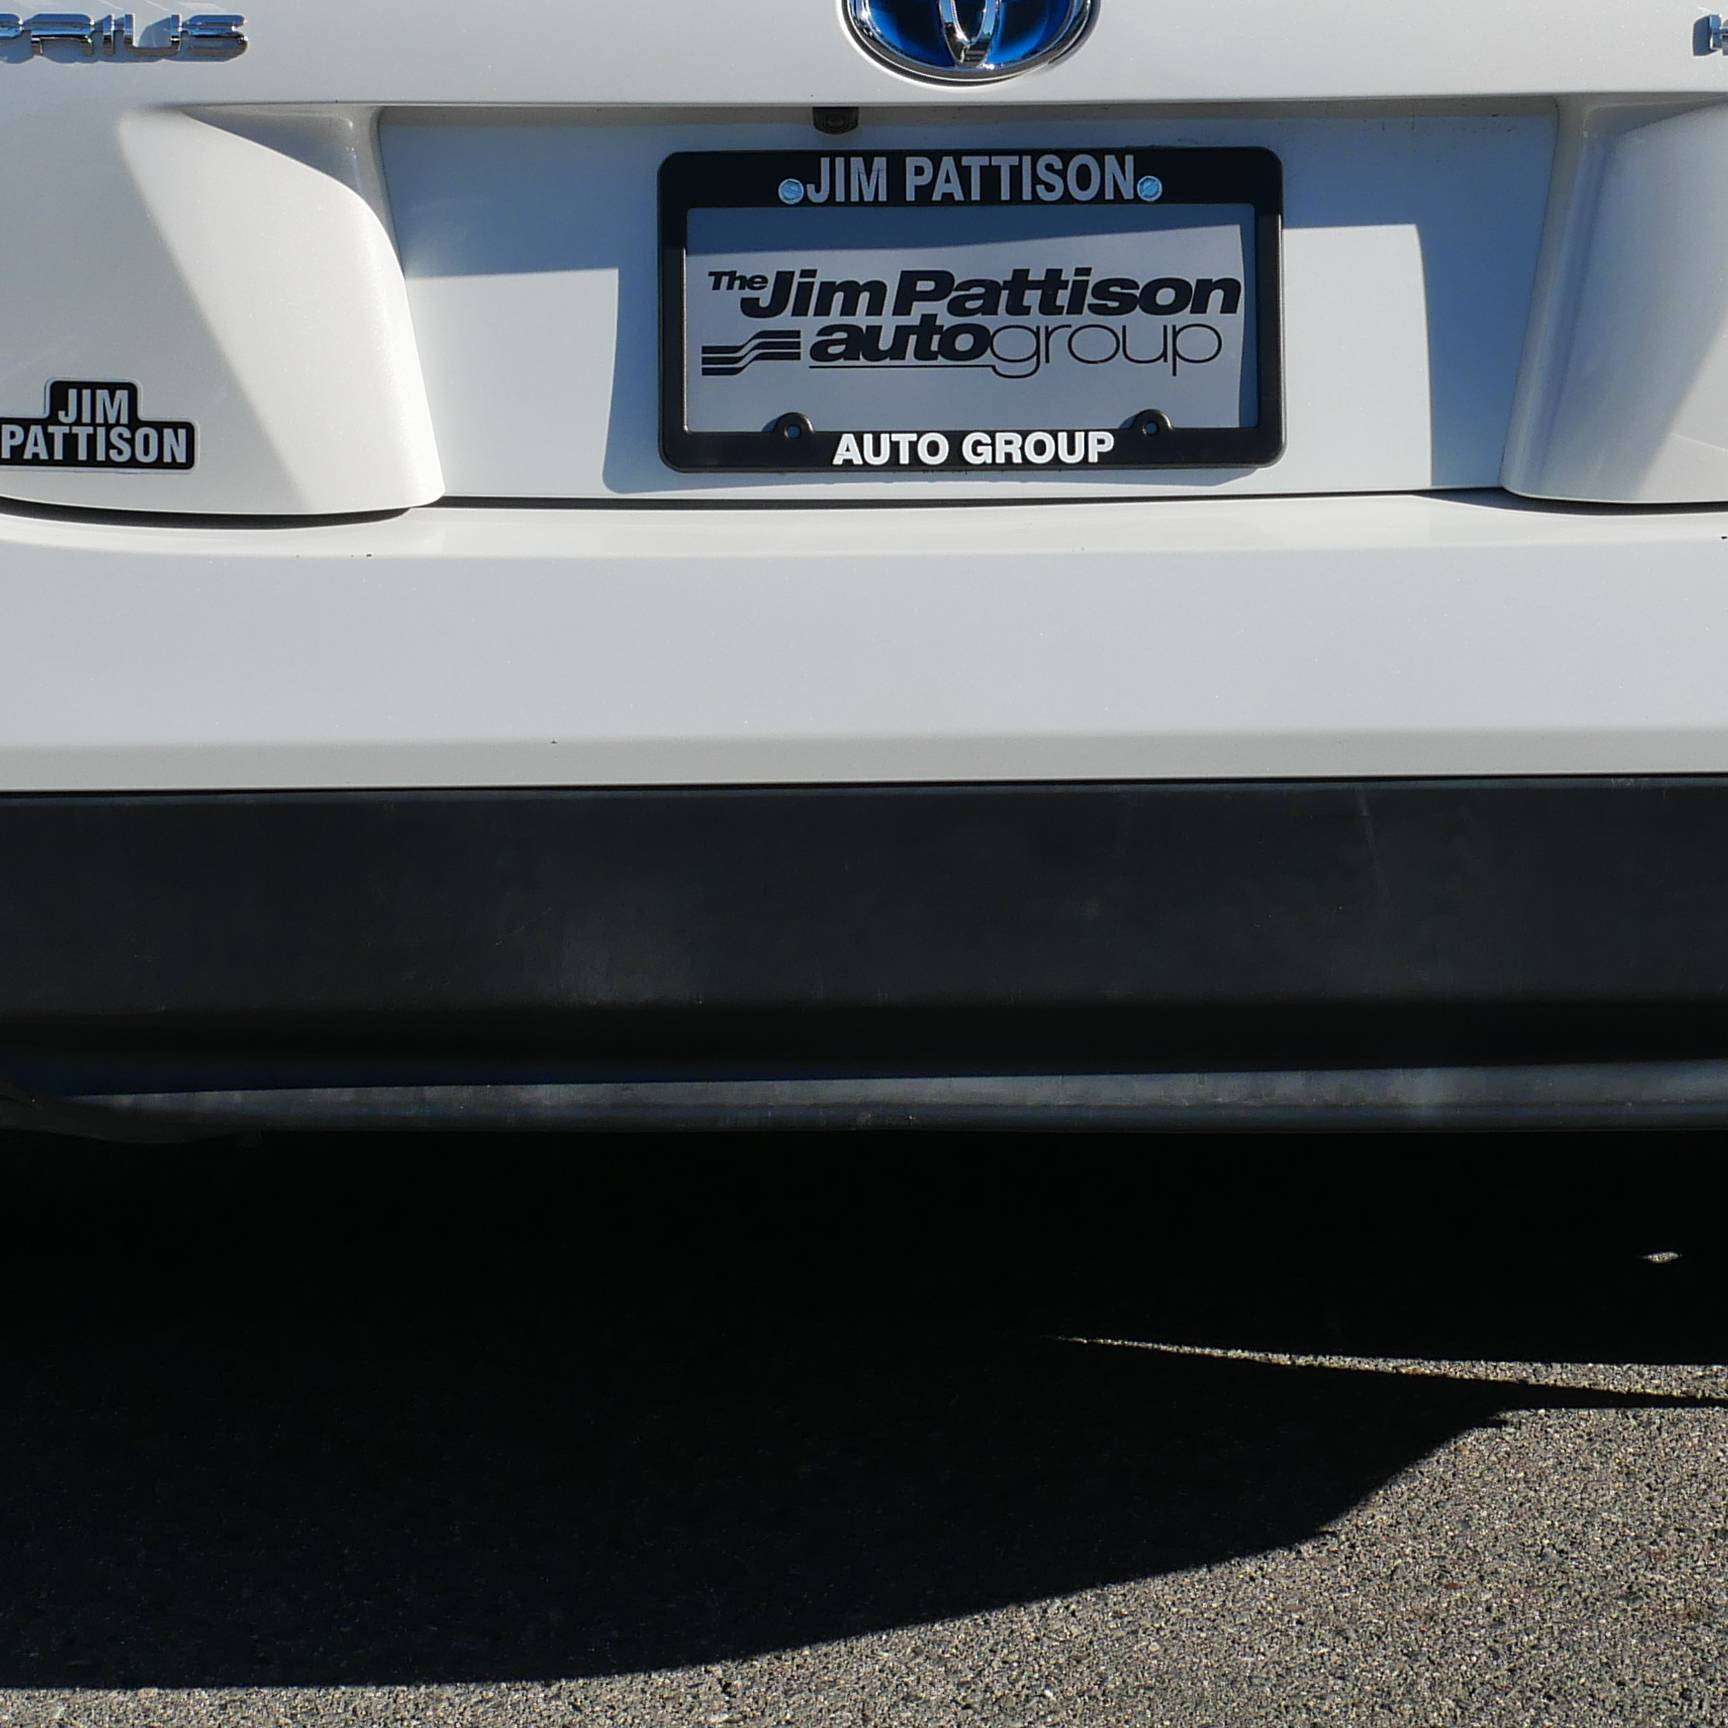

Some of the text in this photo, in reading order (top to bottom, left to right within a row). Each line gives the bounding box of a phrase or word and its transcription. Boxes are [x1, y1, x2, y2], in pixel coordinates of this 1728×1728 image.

[806, 154, 1135, 203] JIM PATTISON
[708, 270, 769, 292] The
[58, 388, 129, 424] JIM
[0, 423, 188, 464] PATTISON
[832, 431, 1116, 466] AUTO GROUP
